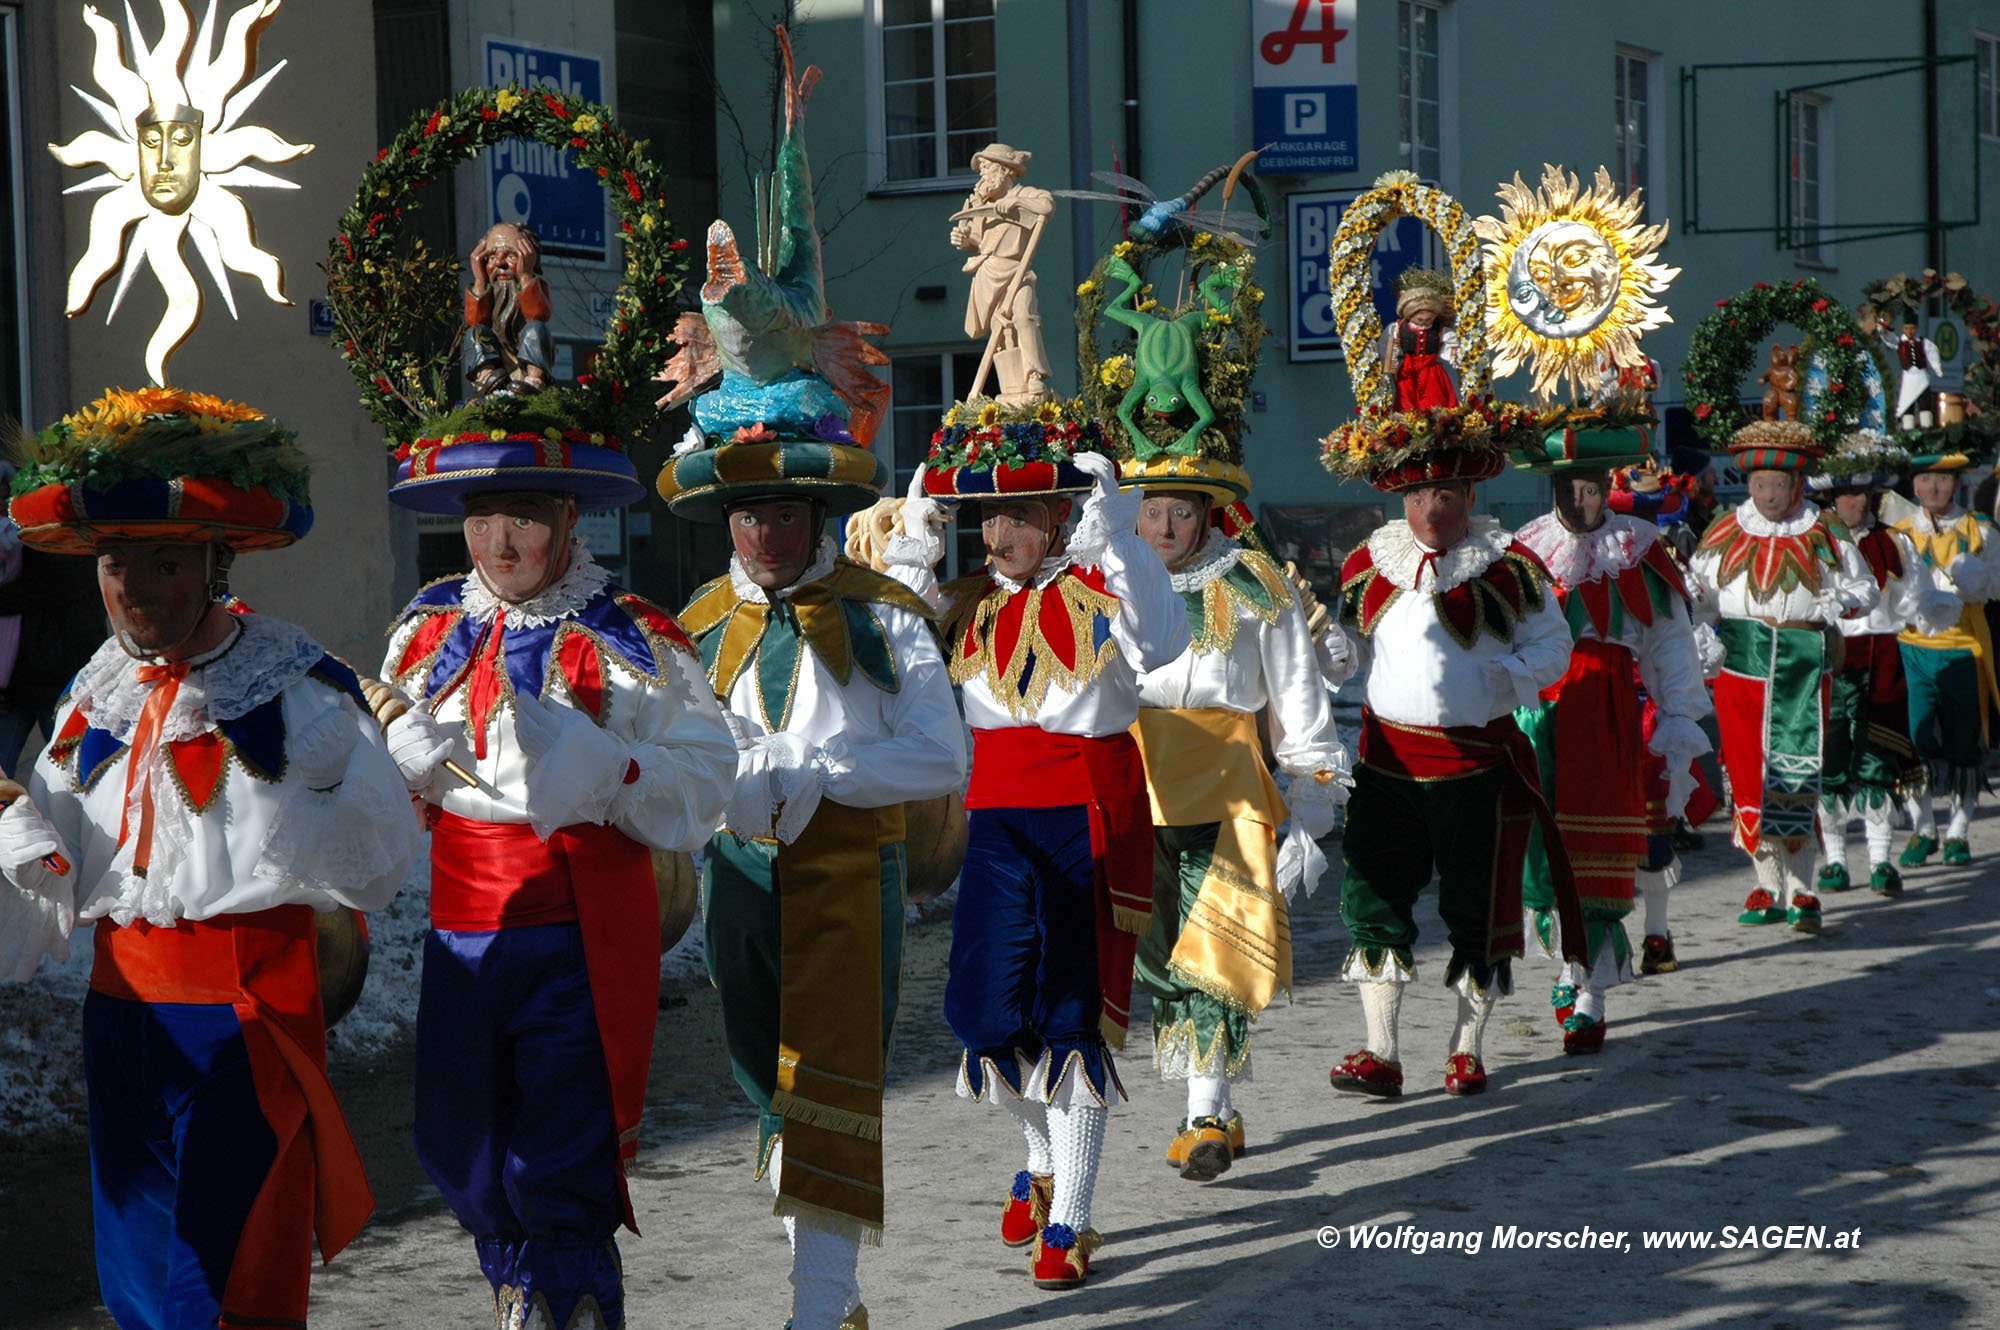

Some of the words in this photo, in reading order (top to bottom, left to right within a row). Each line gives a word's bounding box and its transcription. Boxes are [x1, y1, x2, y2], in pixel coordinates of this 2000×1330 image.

[1295, 99, 1317, 128] P
[1259, 154, 1355, 169] GEBÜHRENFREI
[1301, 205, 1401, 257] Blk
[1301, 260, 1383, 293] Put
